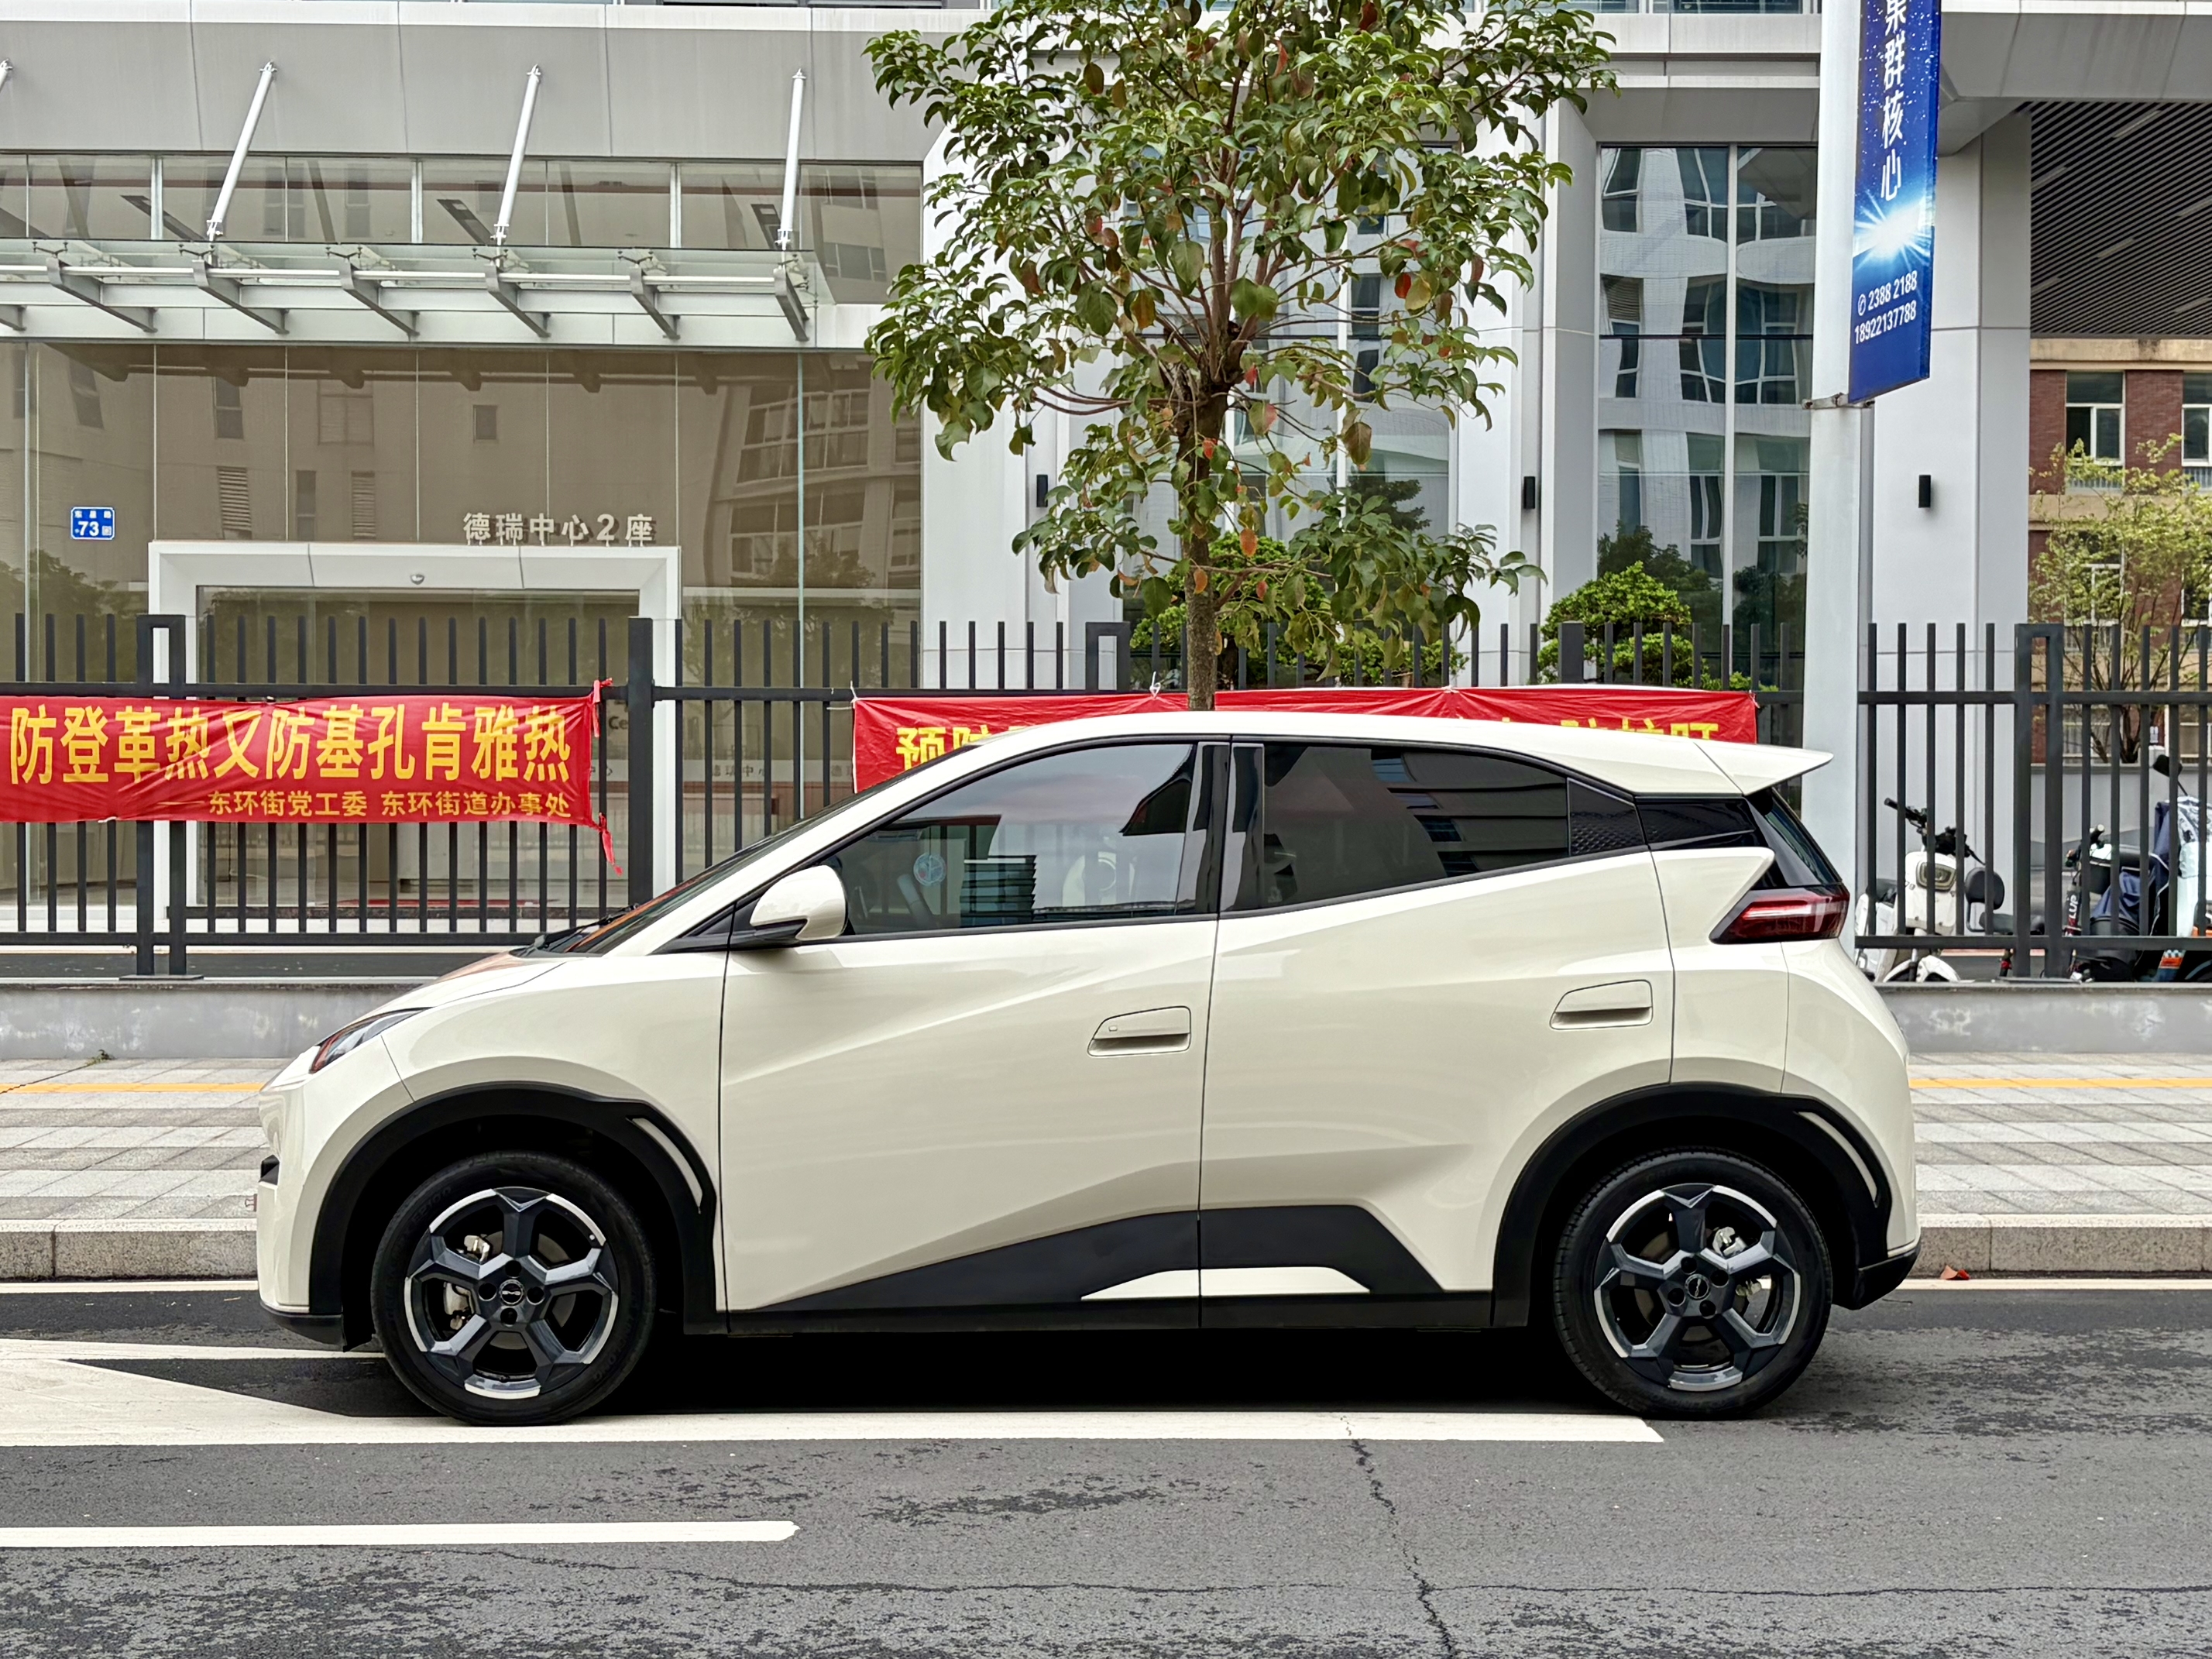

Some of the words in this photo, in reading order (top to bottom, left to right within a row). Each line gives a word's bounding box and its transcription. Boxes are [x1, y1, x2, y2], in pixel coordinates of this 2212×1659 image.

[1868, 282, 1891, 311] 2388
[1893, 270, 1918, 300] 2188
[1854, 300, 1917, 345] 18922137788
[10, 702, 571, 785] 防登革热又防基孔肯雅热
[380, 790, 572, 818] 东环街道办事处
